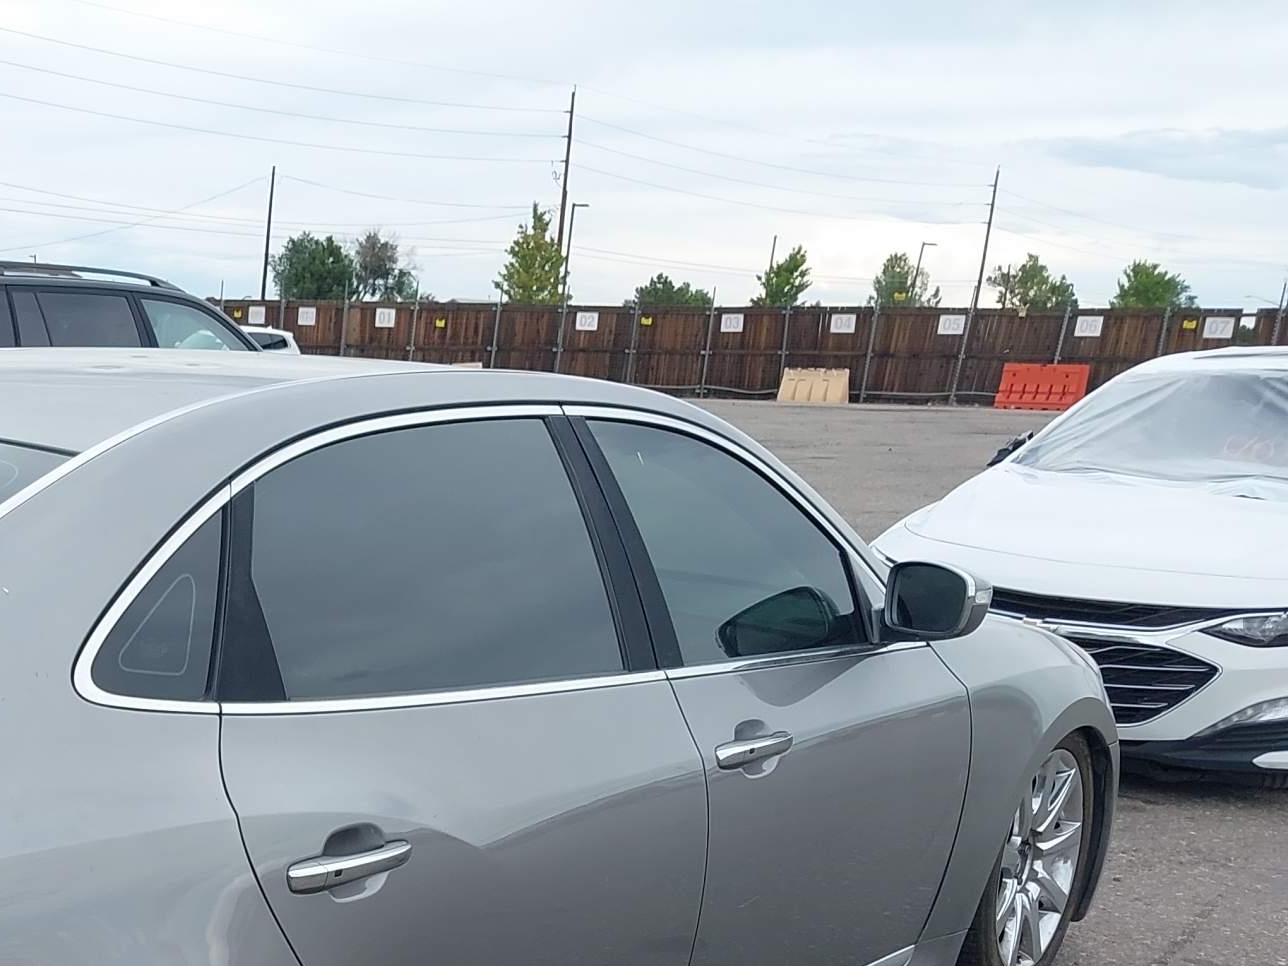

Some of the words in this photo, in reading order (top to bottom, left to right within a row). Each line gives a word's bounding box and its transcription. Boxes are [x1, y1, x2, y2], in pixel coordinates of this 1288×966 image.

[378, 311, 392, 325] 01
[579, 313, 596, 328] 02
[724, 316, 741, 330] 03
[835, 316, 852, 330] 04
[943, 318, 961, 332] 05
[1079, 319, 1097, 333] 06
[1209, 319, 1230, 334] 07
